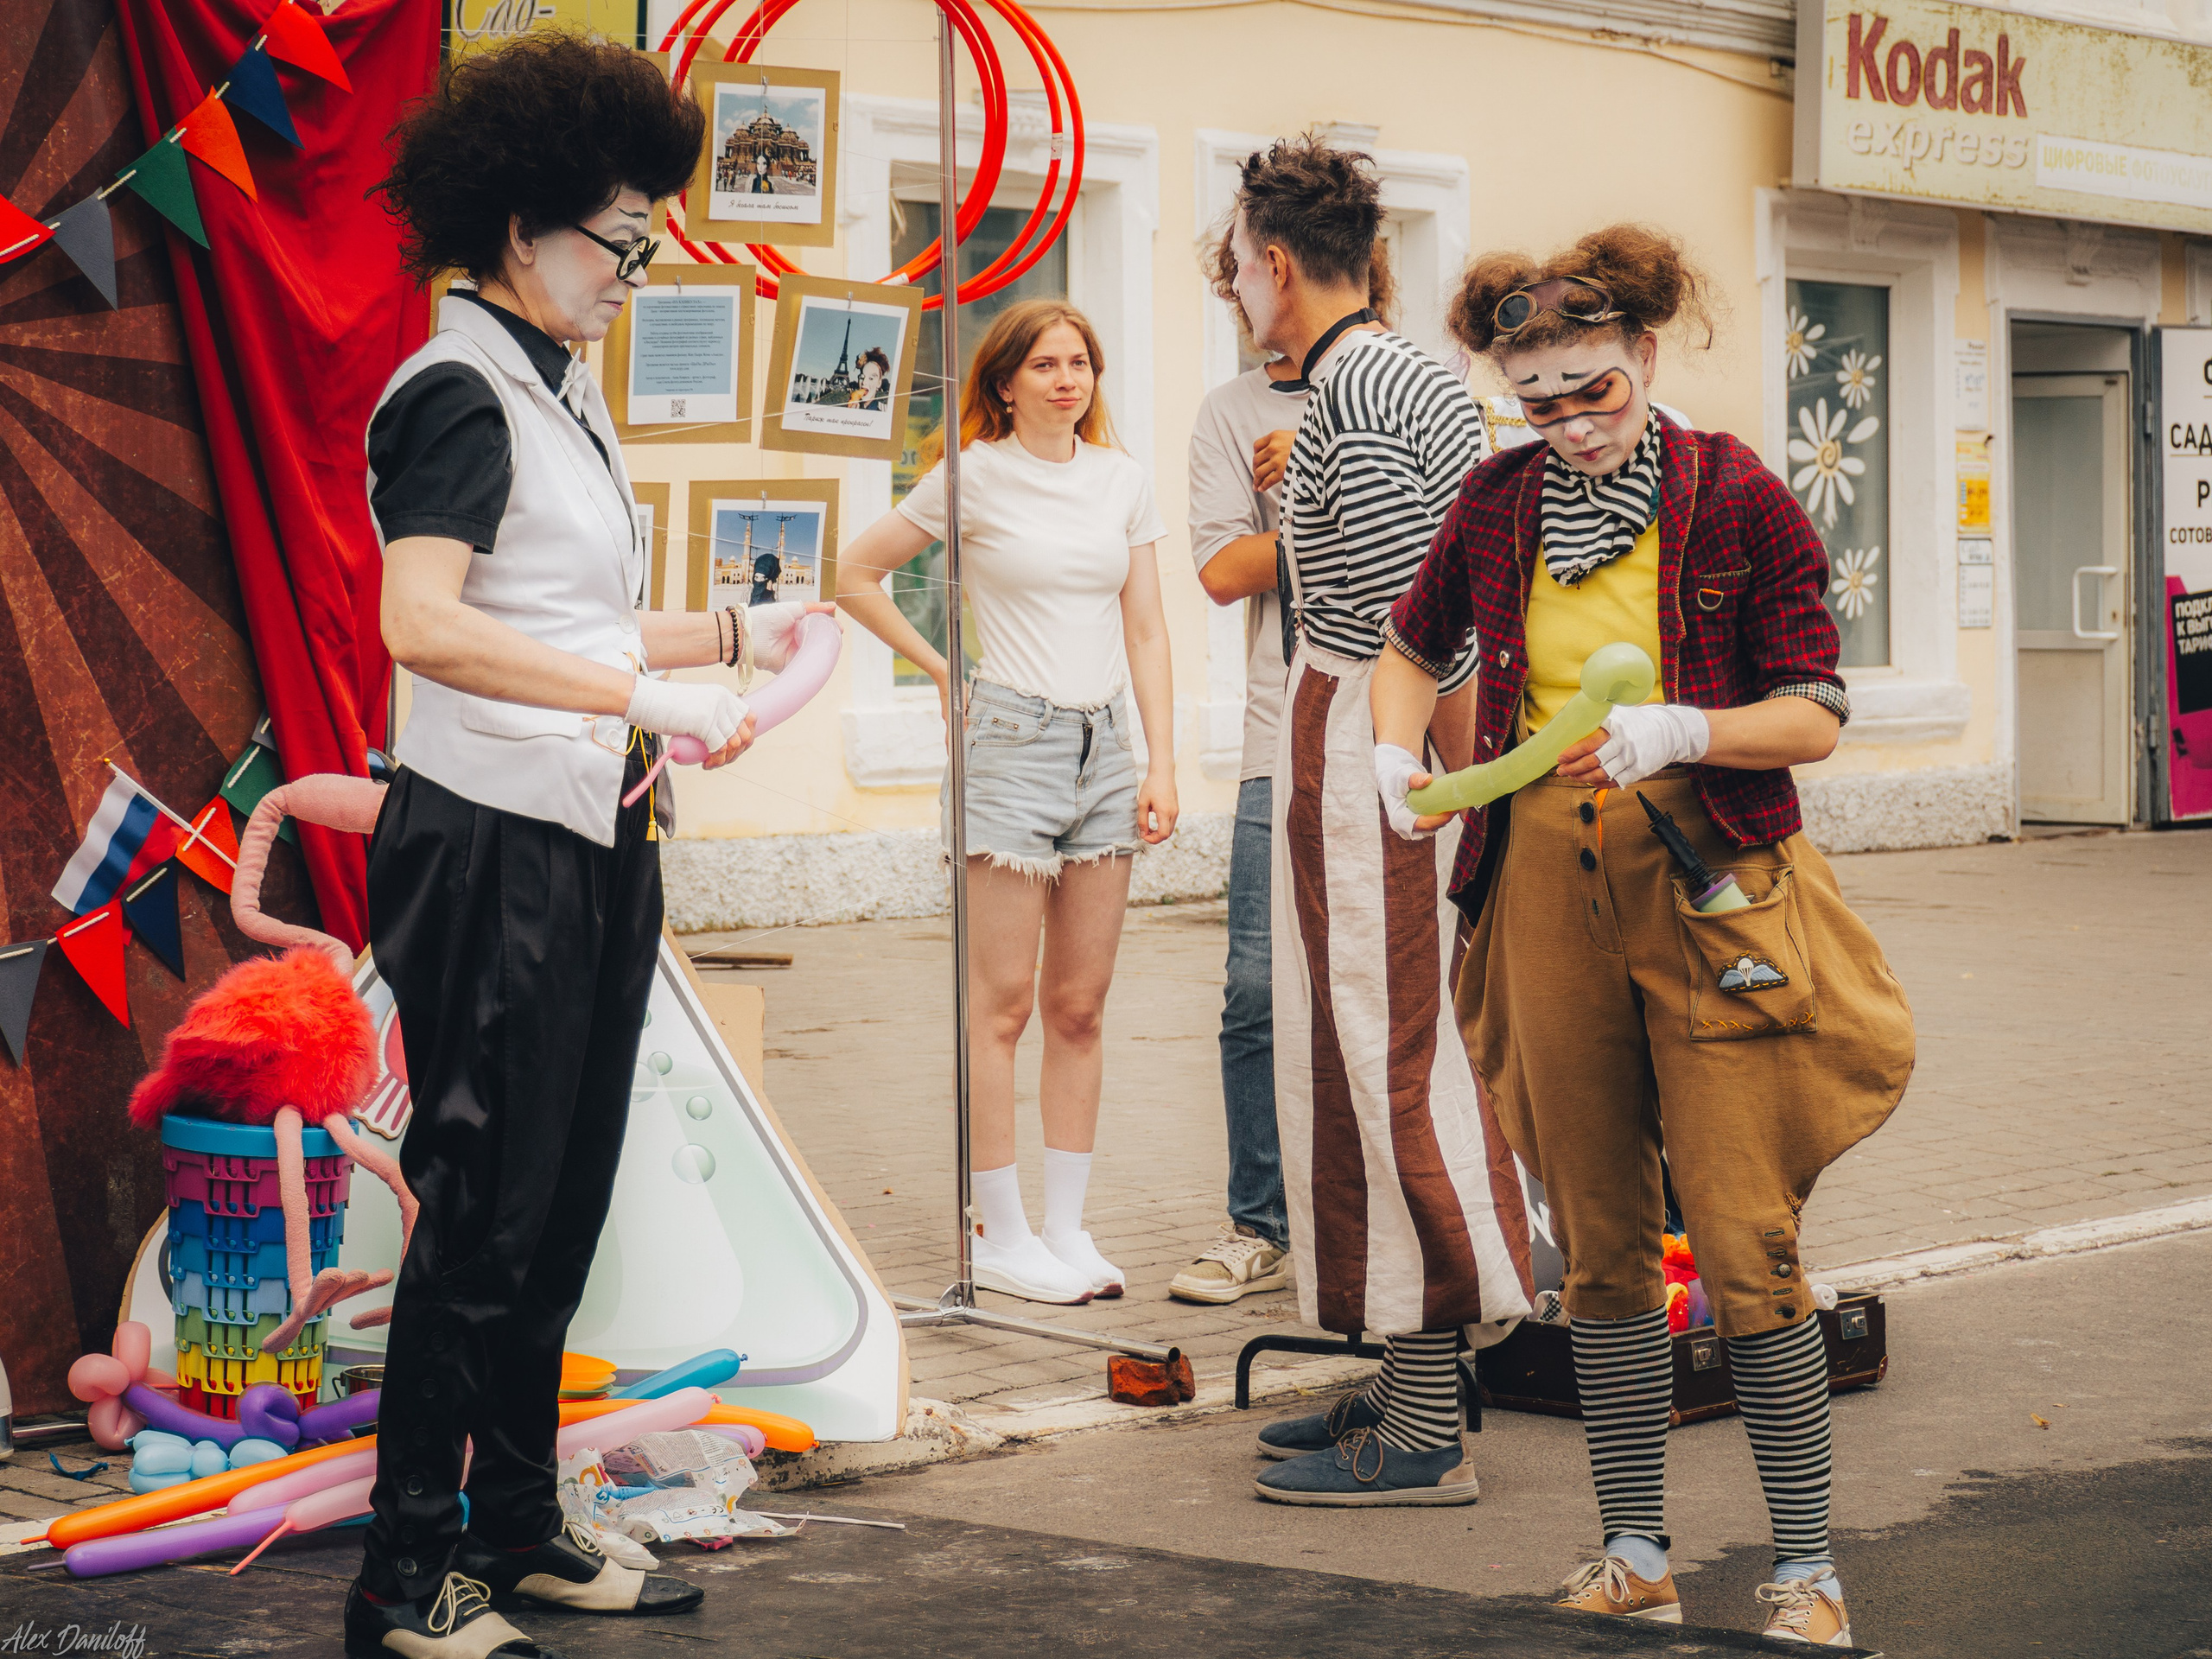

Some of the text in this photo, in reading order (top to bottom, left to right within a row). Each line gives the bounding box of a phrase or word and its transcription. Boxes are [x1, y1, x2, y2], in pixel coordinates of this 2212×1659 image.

[1846, 12, 2029, 118] Kodak
[1847, 117, 2031, 171] express
[2043, 145, 2128, 178] ЦИФРОВЫЕ
[804, 413, 824, 423] Париж
[2197, 479, 2212, 508] Р
[2177, 615, 2212, 638] К ВЫГ
